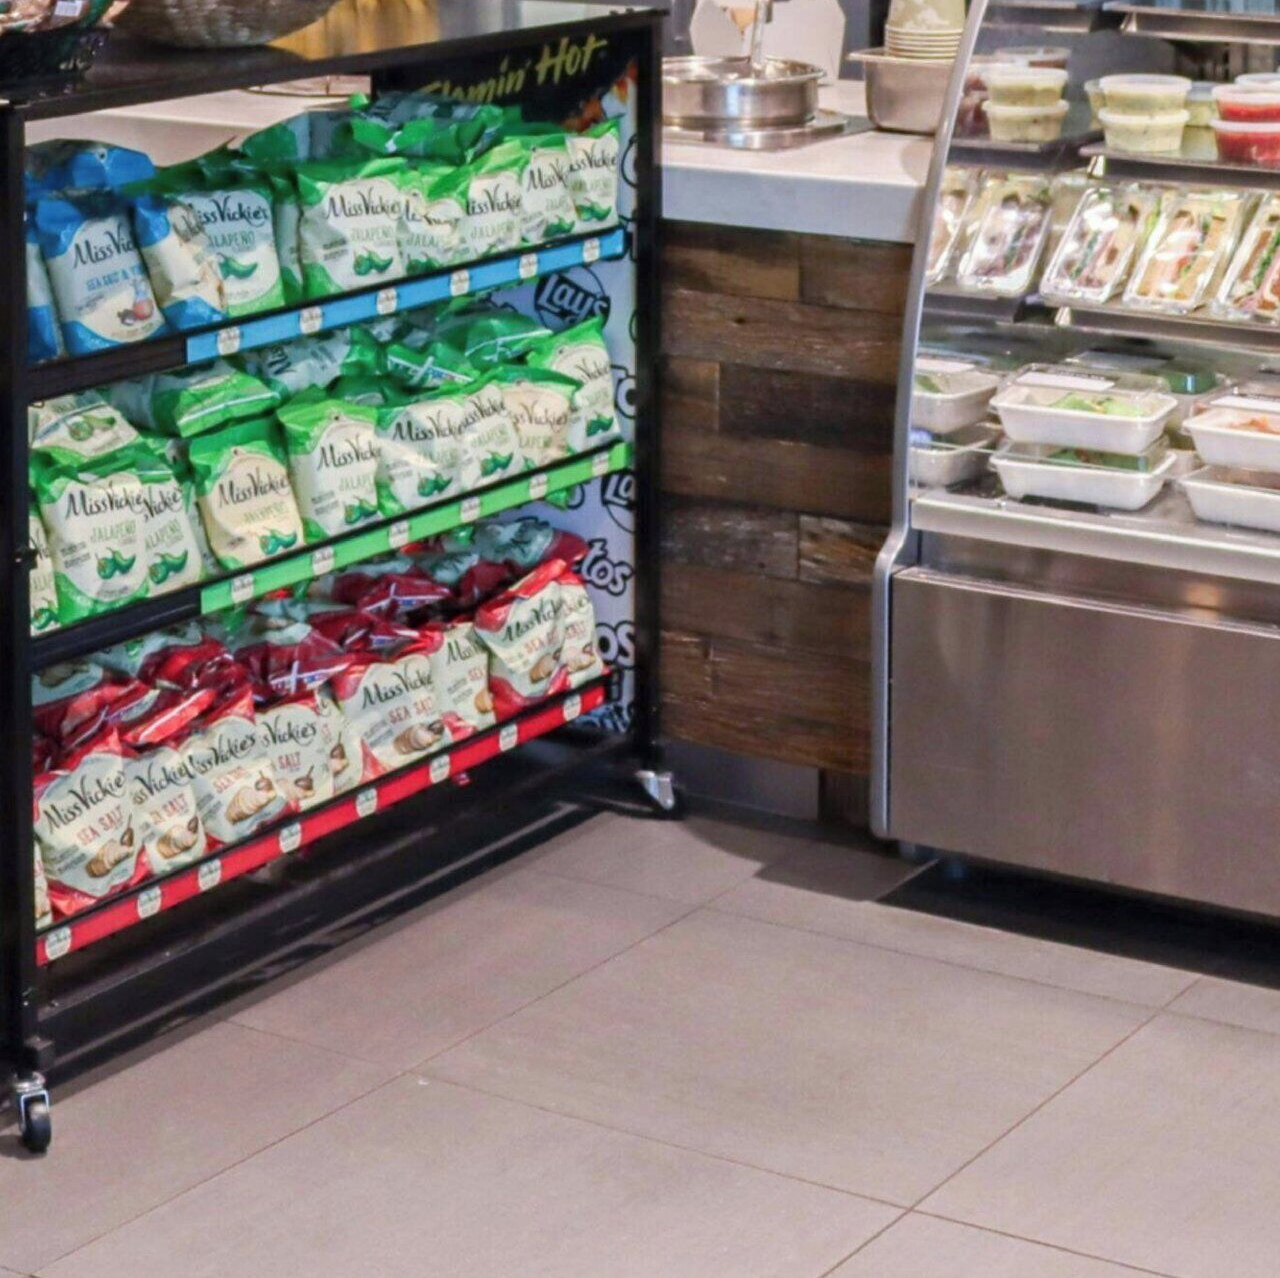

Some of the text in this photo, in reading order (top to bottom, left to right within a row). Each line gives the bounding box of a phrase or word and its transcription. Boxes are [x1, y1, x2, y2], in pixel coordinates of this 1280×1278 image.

[536, 33, 608, 85] Hot
[389, 707, 410, 723] SEA
[267, 718, 318, 745] Vickie's
[211, 733, 256, 766] Vickie's
[278, 752, 301, 769] SALT
[76, 806, 125, 846] SEA SALT
